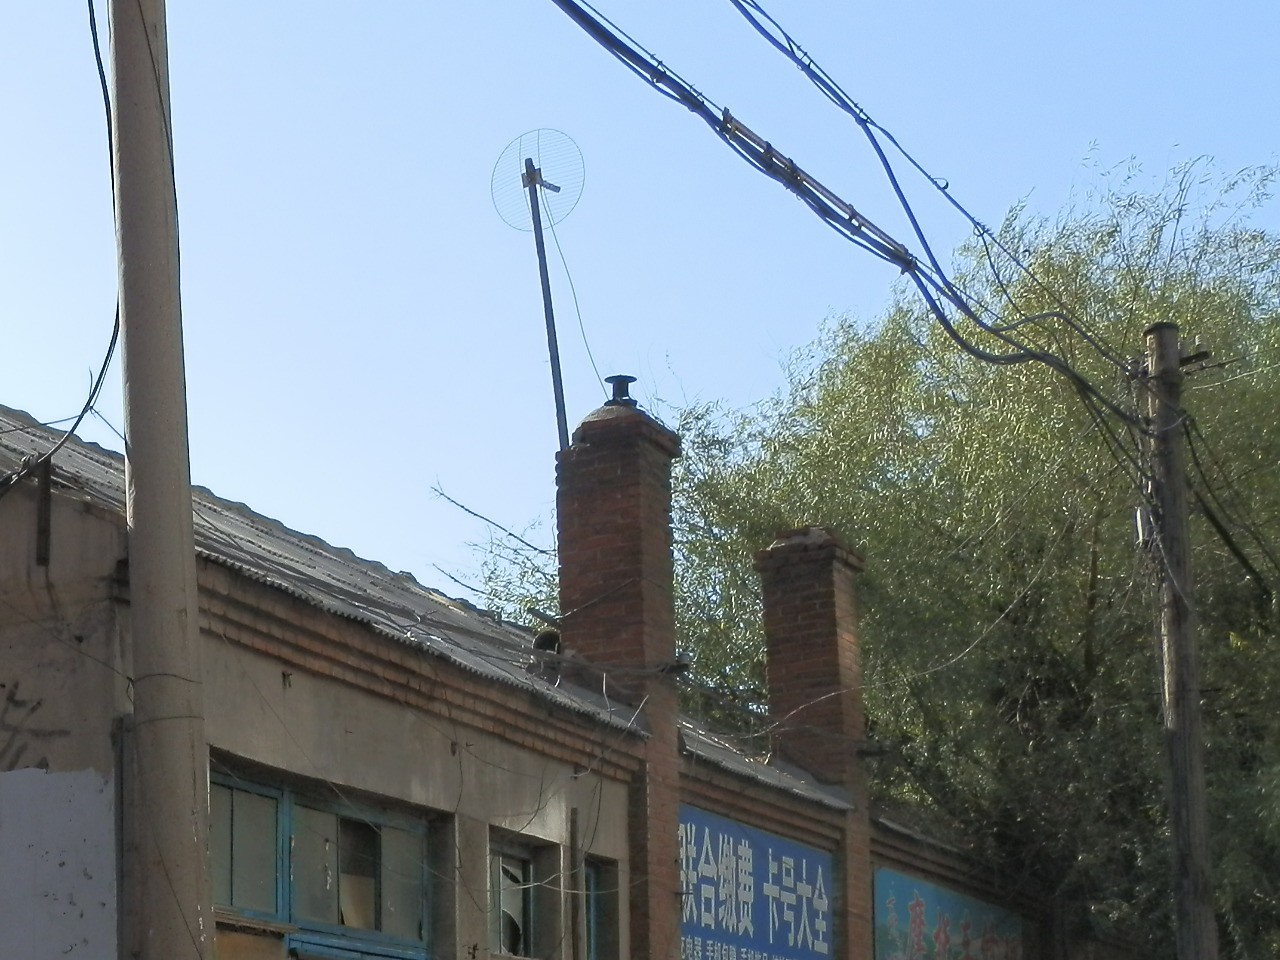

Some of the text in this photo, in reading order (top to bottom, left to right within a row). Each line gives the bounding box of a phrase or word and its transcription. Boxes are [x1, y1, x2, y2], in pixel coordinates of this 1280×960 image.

[678, 822, 754, 939] 联合缴费
[763, 848, 829, 955] 卡号大全
